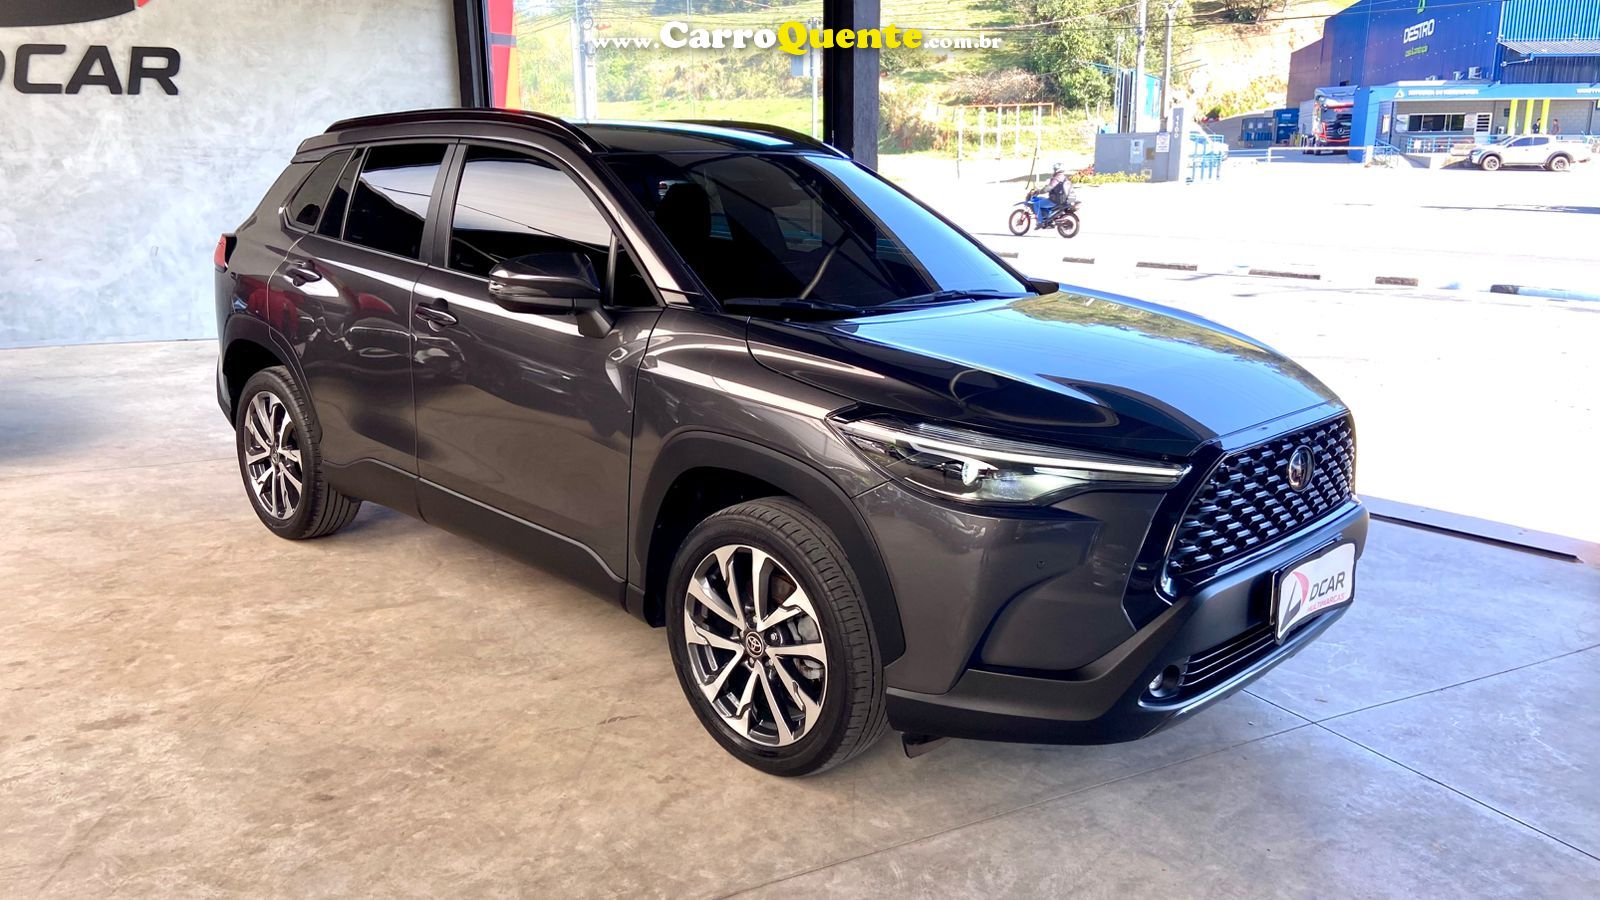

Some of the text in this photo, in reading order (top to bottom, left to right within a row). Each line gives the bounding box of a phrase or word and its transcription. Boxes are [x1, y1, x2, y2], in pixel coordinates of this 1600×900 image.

[1403, 18, 1435, 44] DESTRO
[0, 43, 181, 95] CAR
[1309, 571, 1345, 602] DCAR
